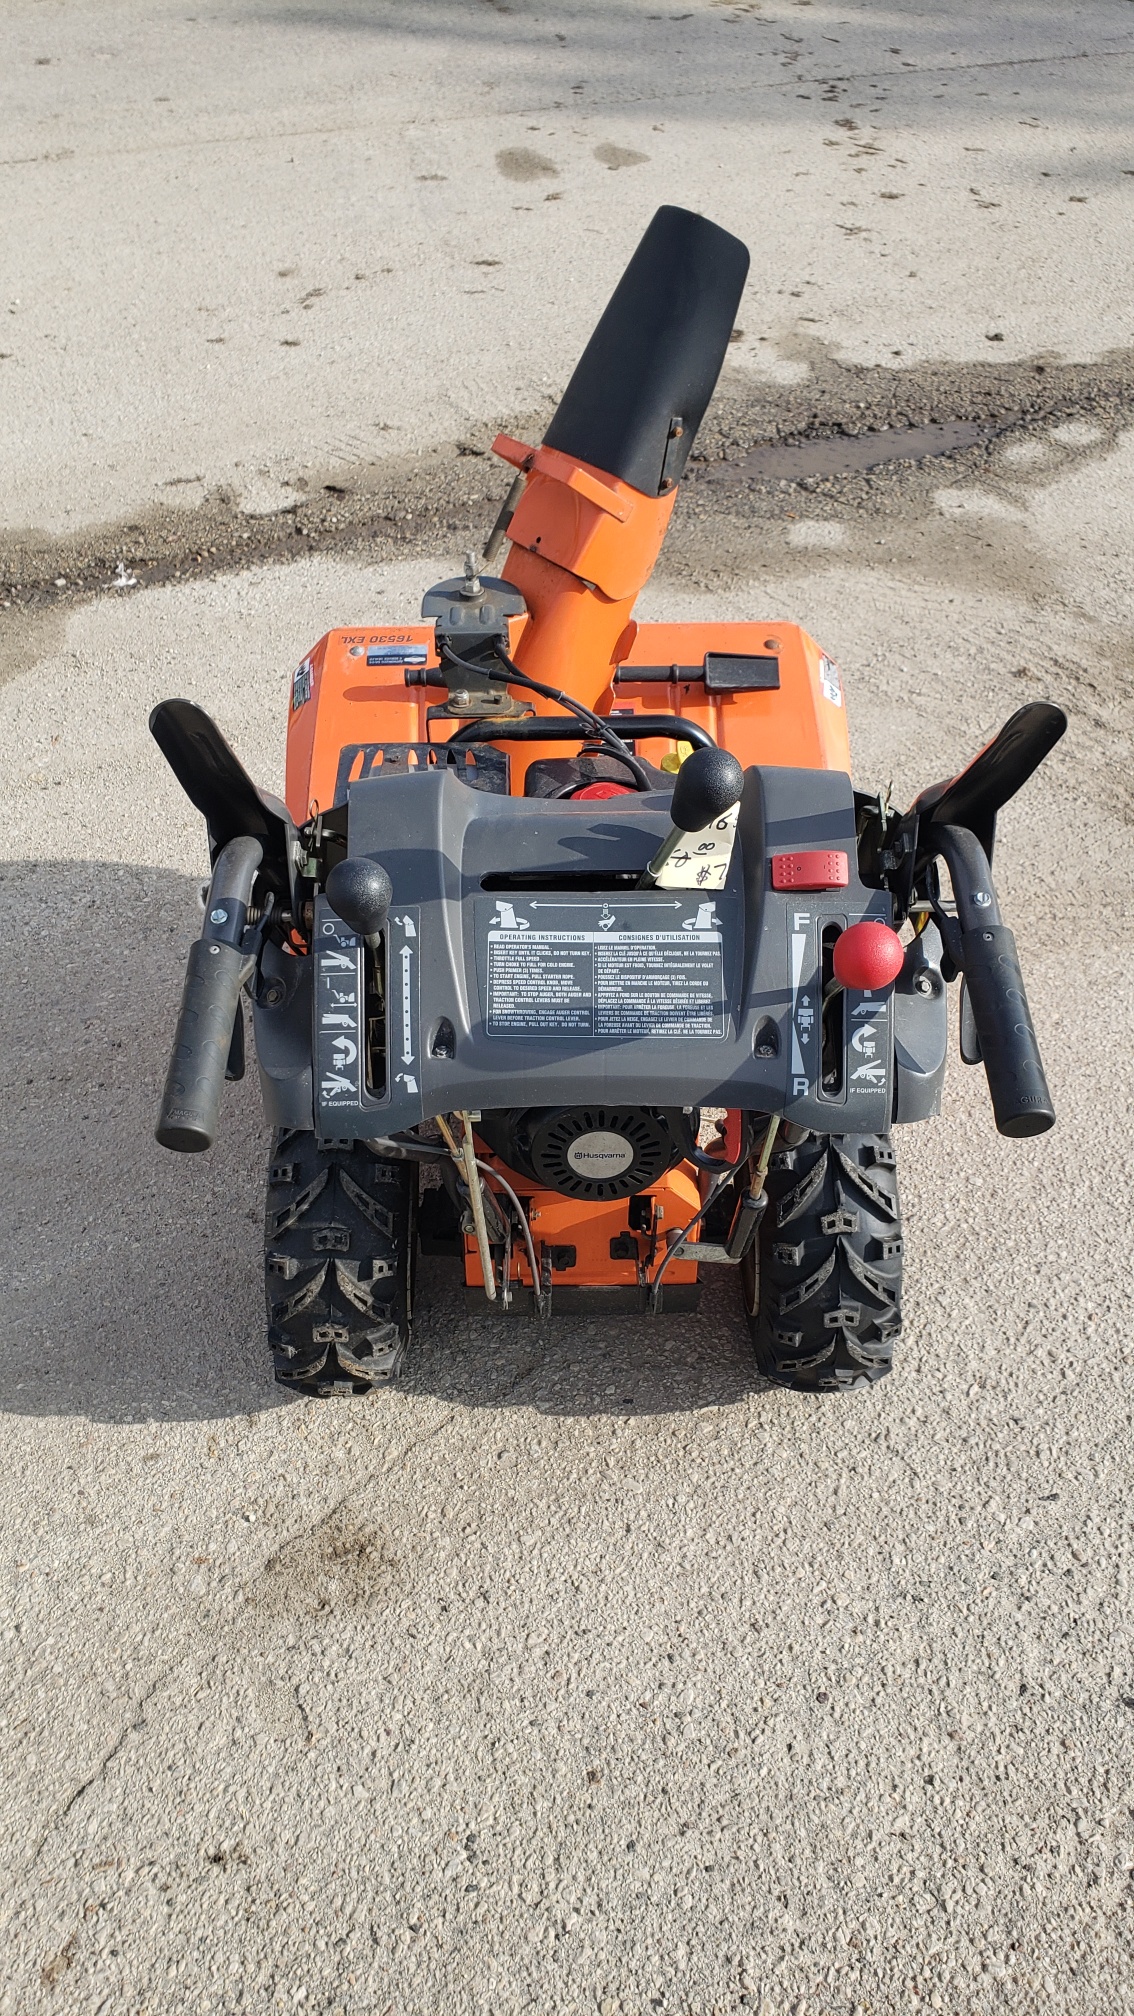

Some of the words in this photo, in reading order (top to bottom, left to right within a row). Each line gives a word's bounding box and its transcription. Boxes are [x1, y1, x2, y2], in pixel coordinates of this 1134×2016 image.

[369, 634, 413, 643] 16530
[794, 913, 810, 930] F
[793, 1078, 809, 1096] R
